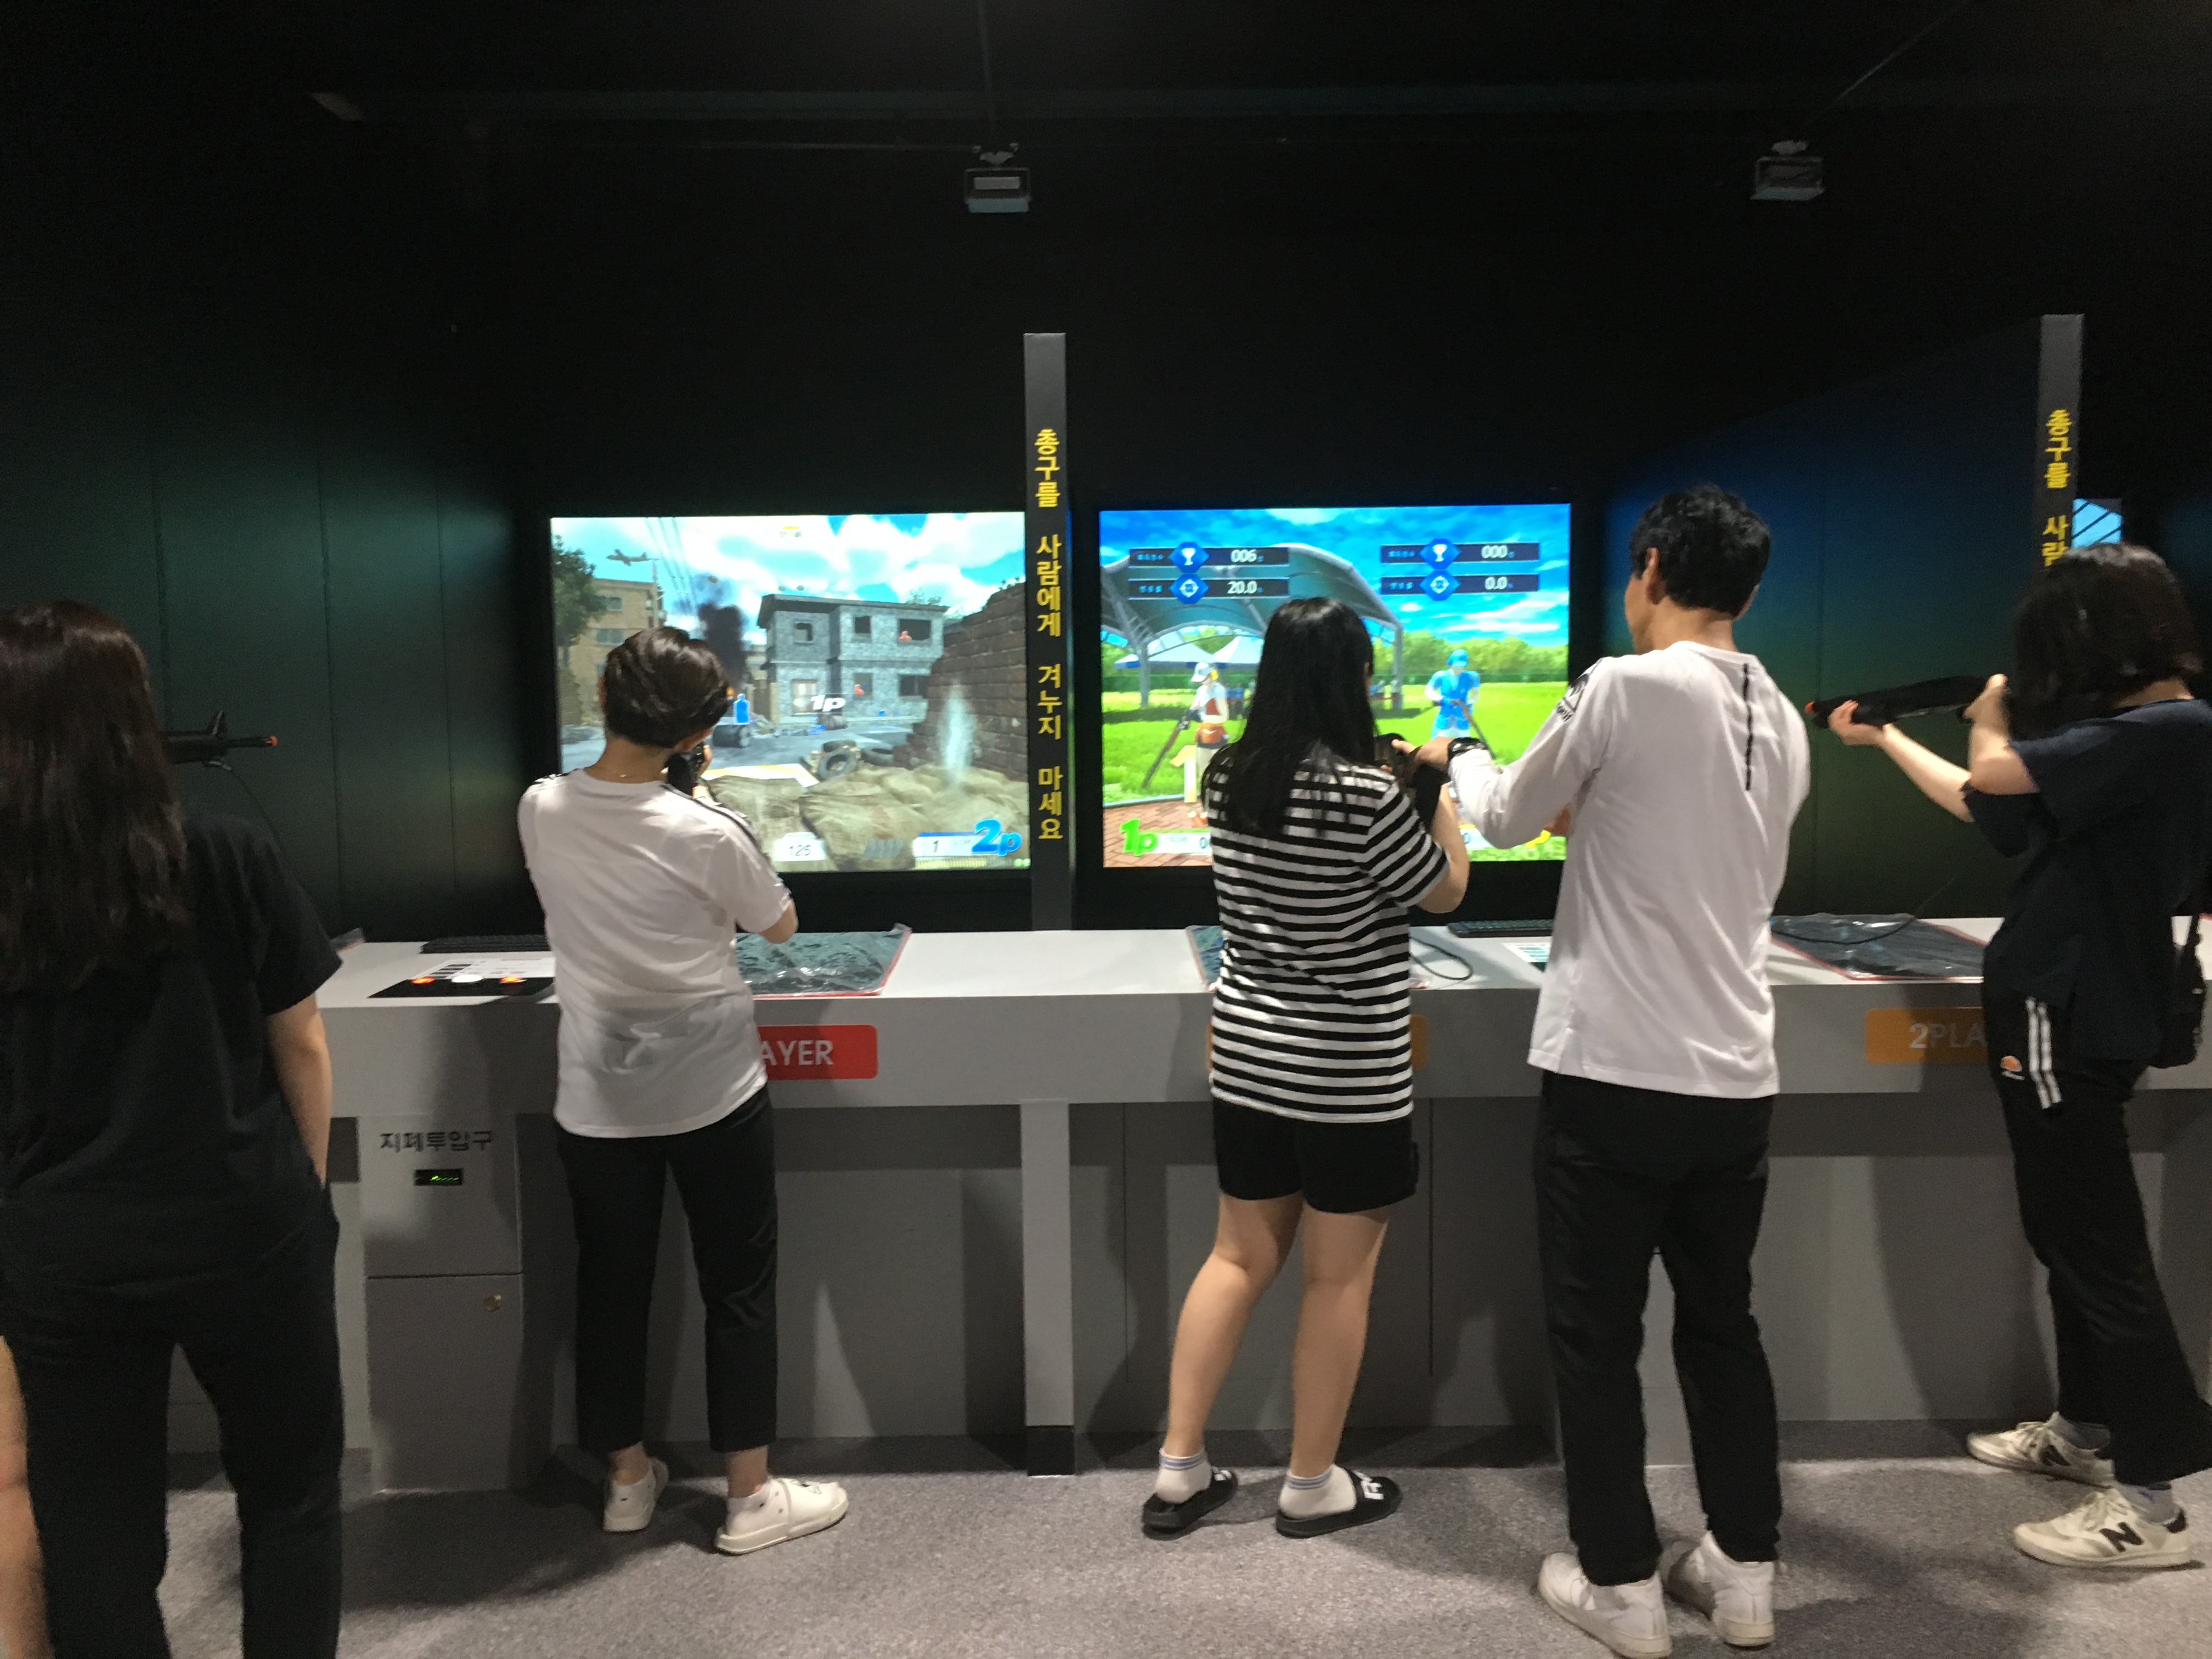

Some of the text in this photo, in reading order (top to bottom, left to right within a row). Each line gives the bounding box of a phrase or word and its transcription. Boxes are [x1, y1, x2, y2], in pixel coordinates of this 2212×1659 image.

[2041, 409, 2073, 567] 총구를 사람
[1230, 549, 1257, 563] 006
[1481, 545, 1508, 559] 000
[1227, 580, 1257, 594] 20.0
[1485, 577, 1508, 590] 0.0
[1034, 428, 1064, 840] 총구를 사람에게 겨누지 마세요
[1909, 1023, 1988, 1049] 2PLA
[760, 1040, 834, 1066] AYER
[380, 1130, 492, 1153] 지폐투입구
[2100, 1521, 2145, 1553] N
